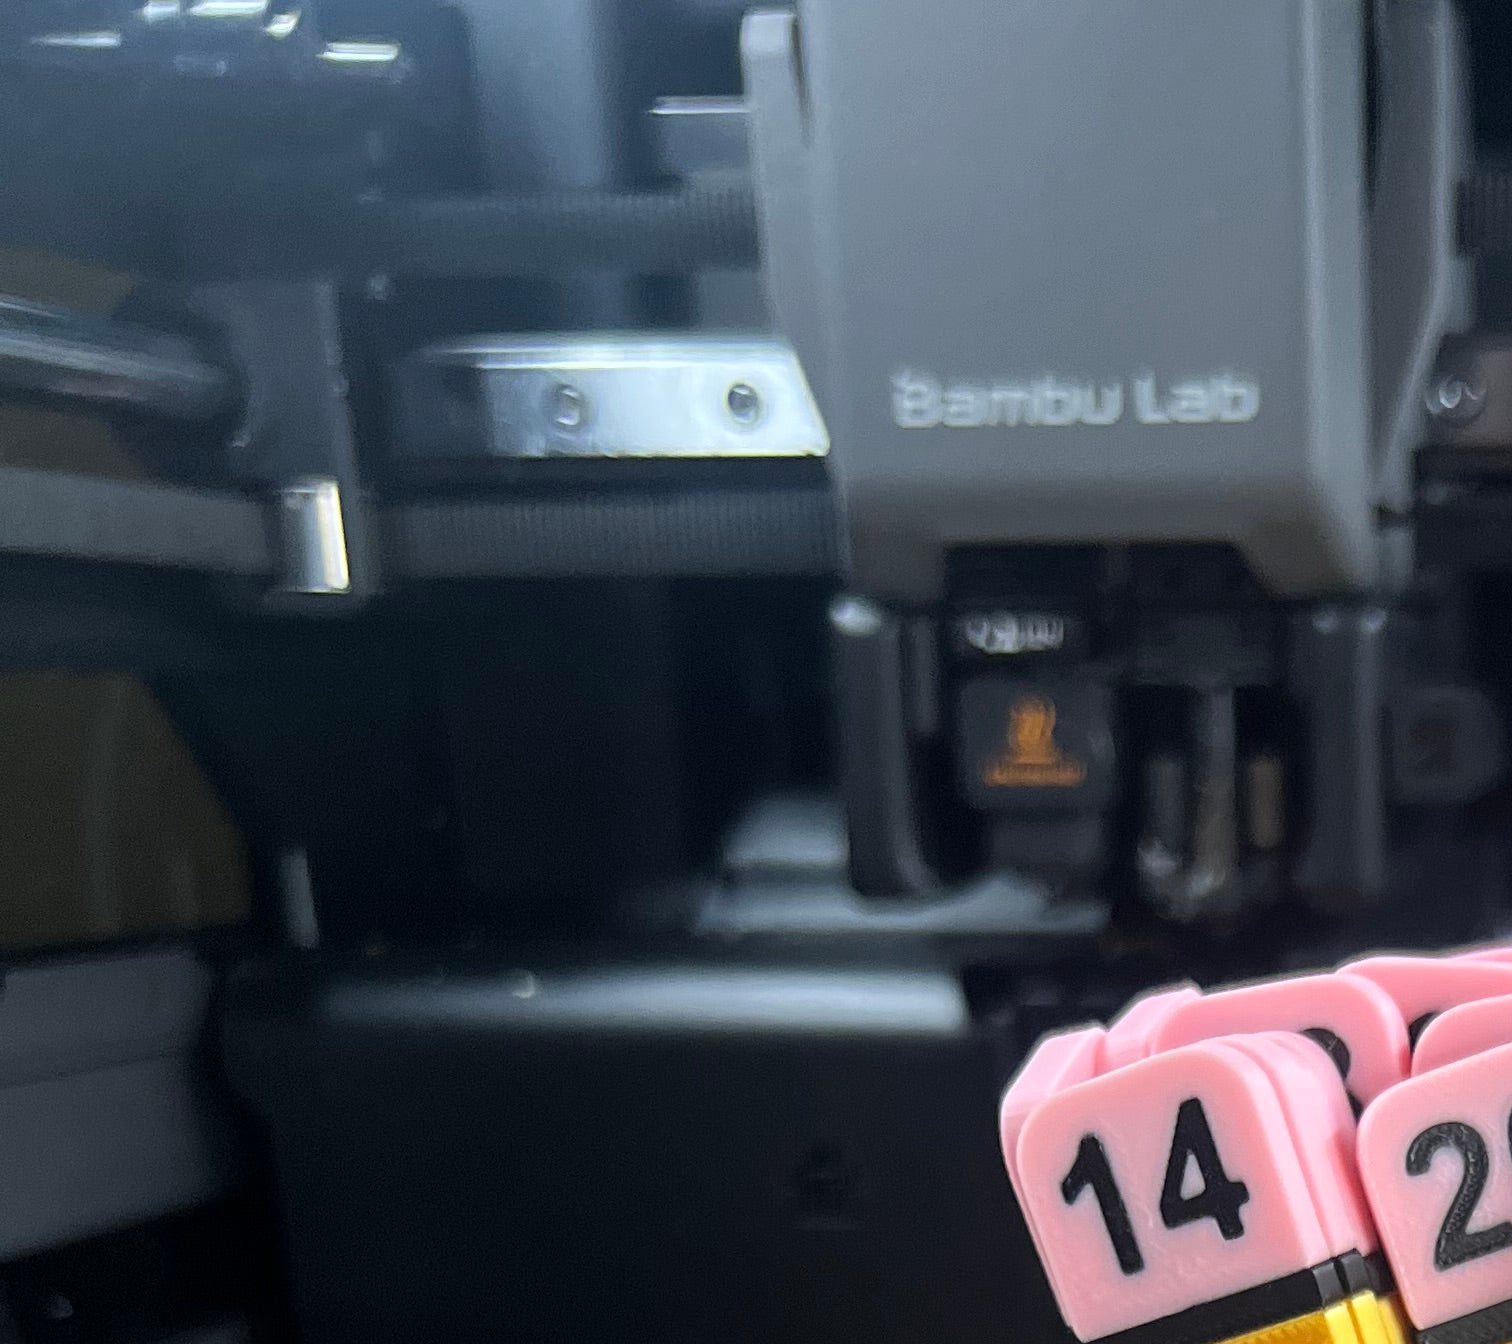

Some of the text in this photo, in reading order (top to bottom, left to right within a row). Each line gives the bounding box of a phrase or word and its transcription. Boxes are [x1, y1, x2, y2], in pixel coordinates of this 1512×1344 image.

[892, 368, 1259, 428] Bambu Lab
[1062, 1096, 1250, 1277] 14
